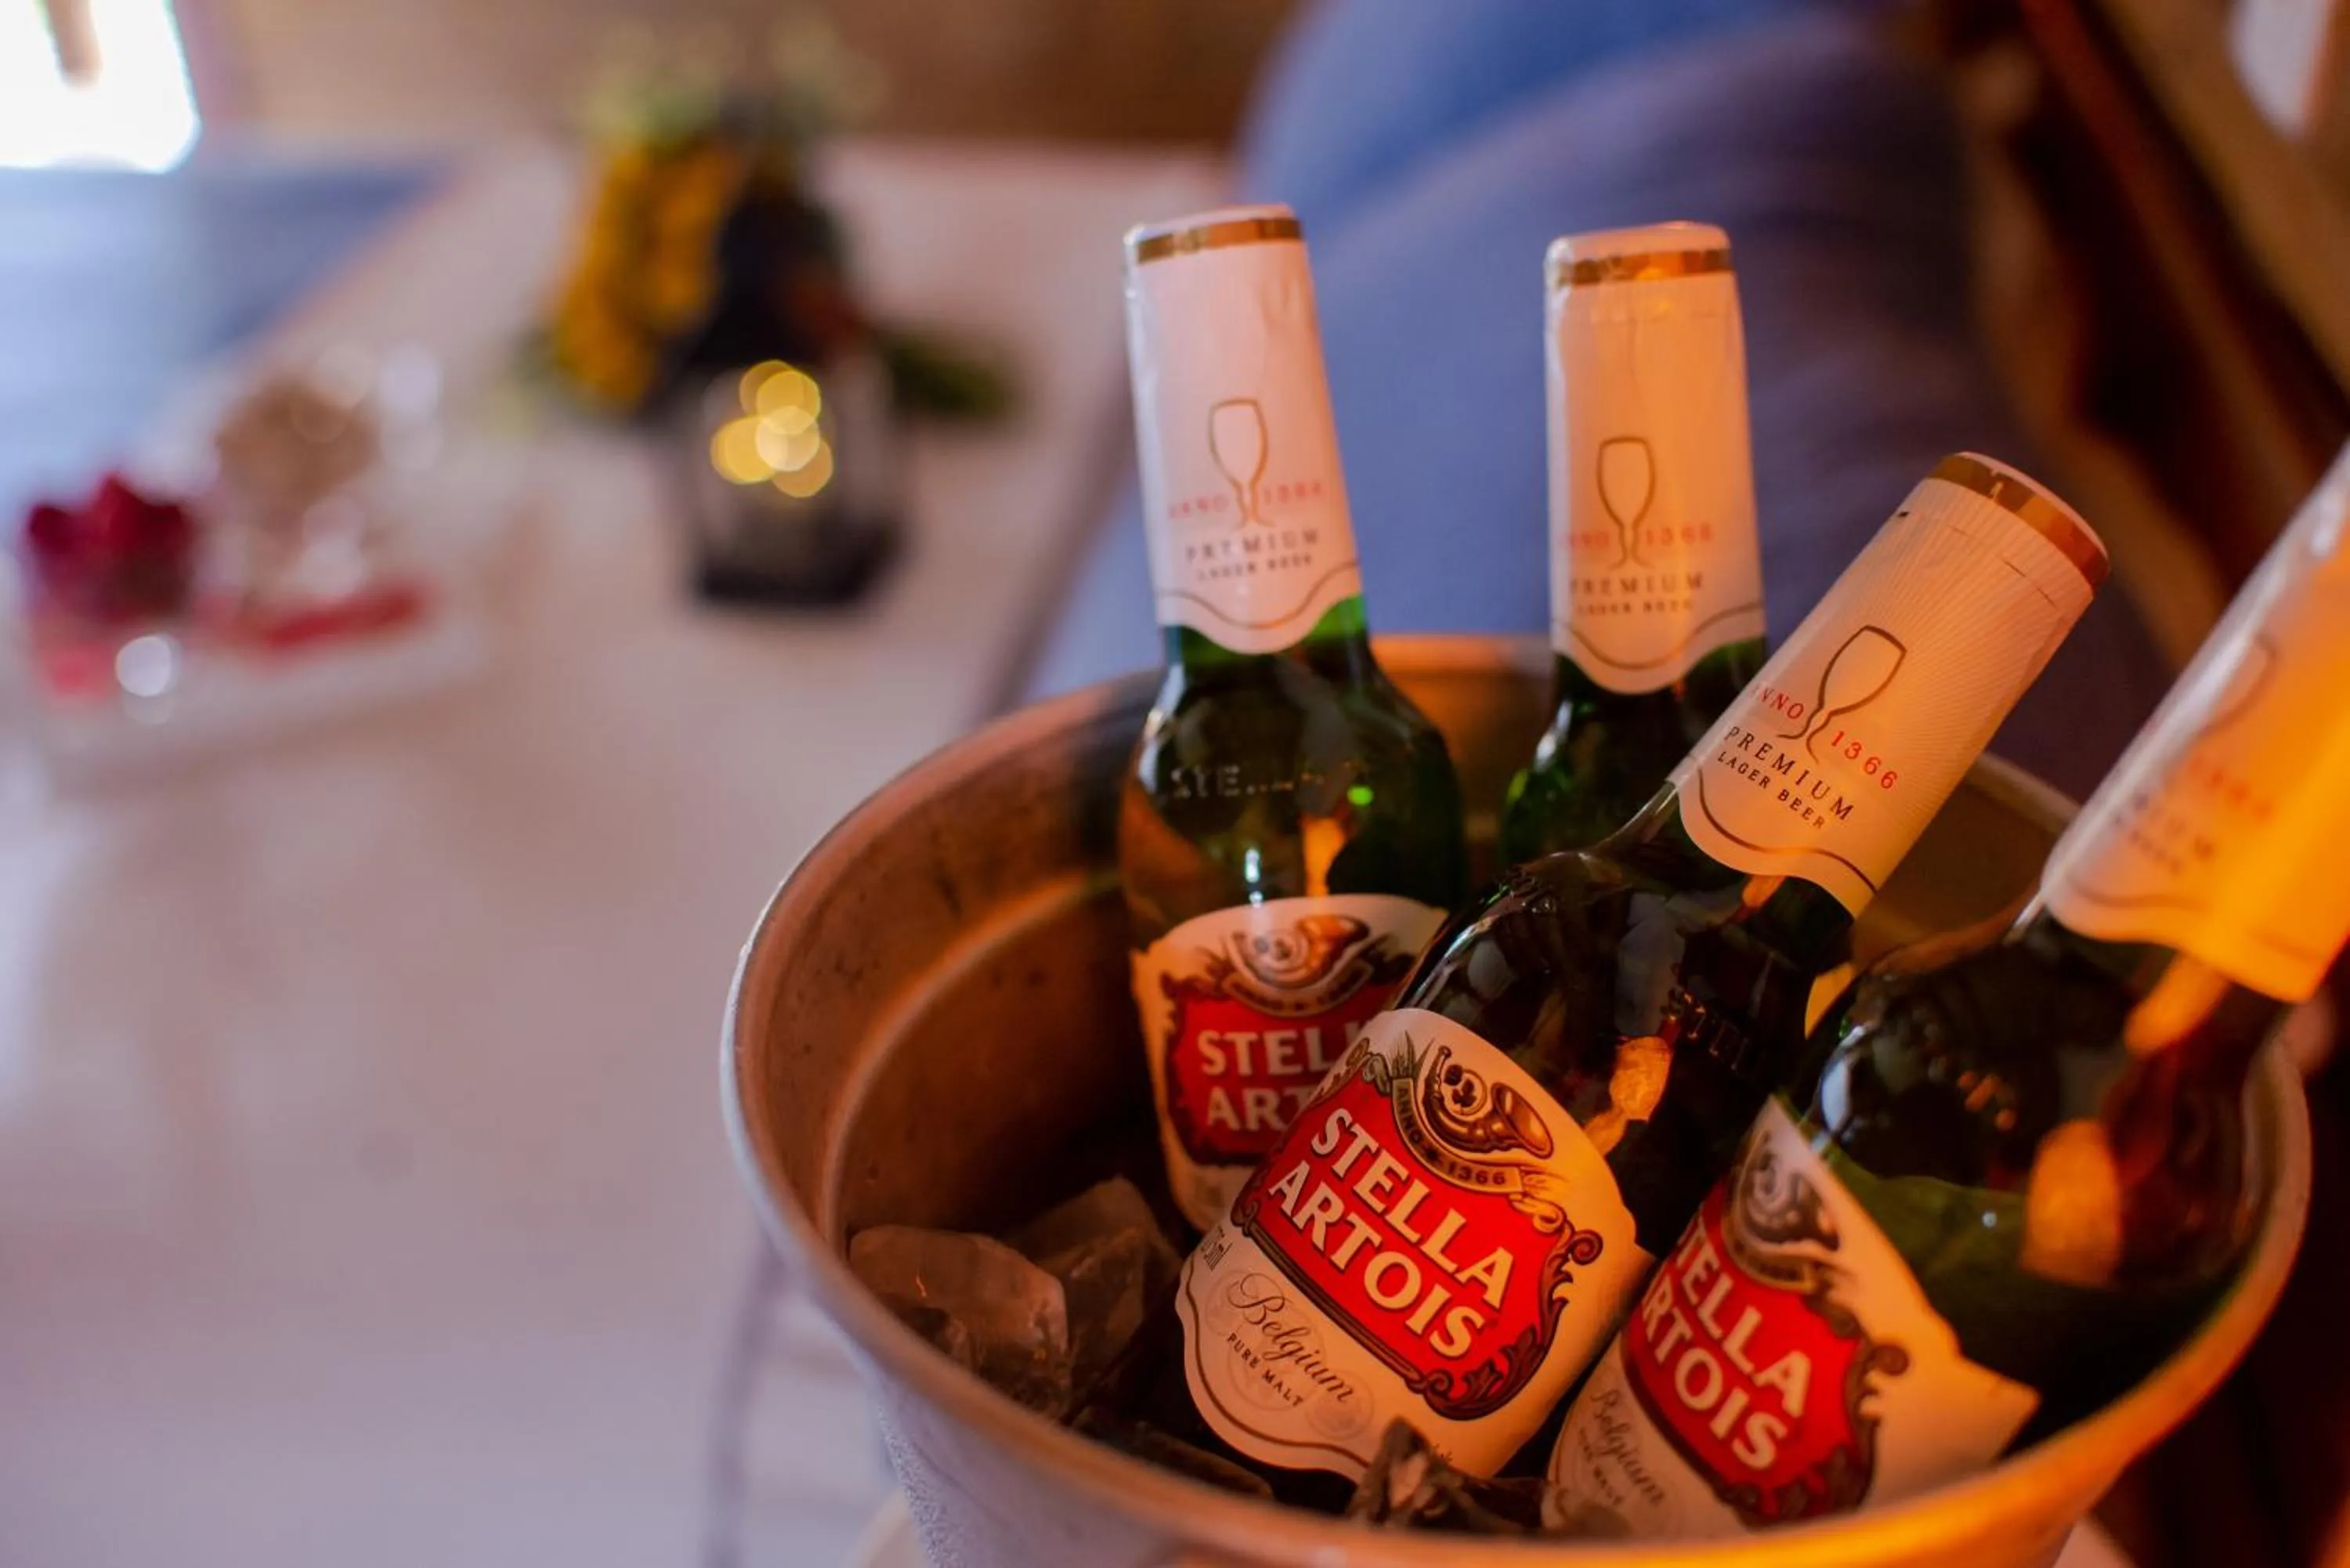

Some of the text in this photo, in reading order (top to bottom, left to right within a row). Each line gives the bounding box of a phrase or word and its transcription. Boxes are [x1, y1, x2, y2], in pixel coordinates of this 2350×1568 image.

[1718, 751, 1825, 829] LAGER BEER
[1724, 726, 1854, 820] PREMIUM
[1831, 731, 1898, 789] 1366
[1311, 1108, 1515, 1309] STELLA
[1448, 1162, 1506, 1184] 1366
[1268, 1160, 1486, 1359] ARTOIS
[1677, 1212, 1811, 1418] TELLA
[1226, 1332, 1303, 1407] PURE MALT
[1227, 1272, 1354, 1402] Belgium
[1642, 1270, 1789, 1469] RTOIS
